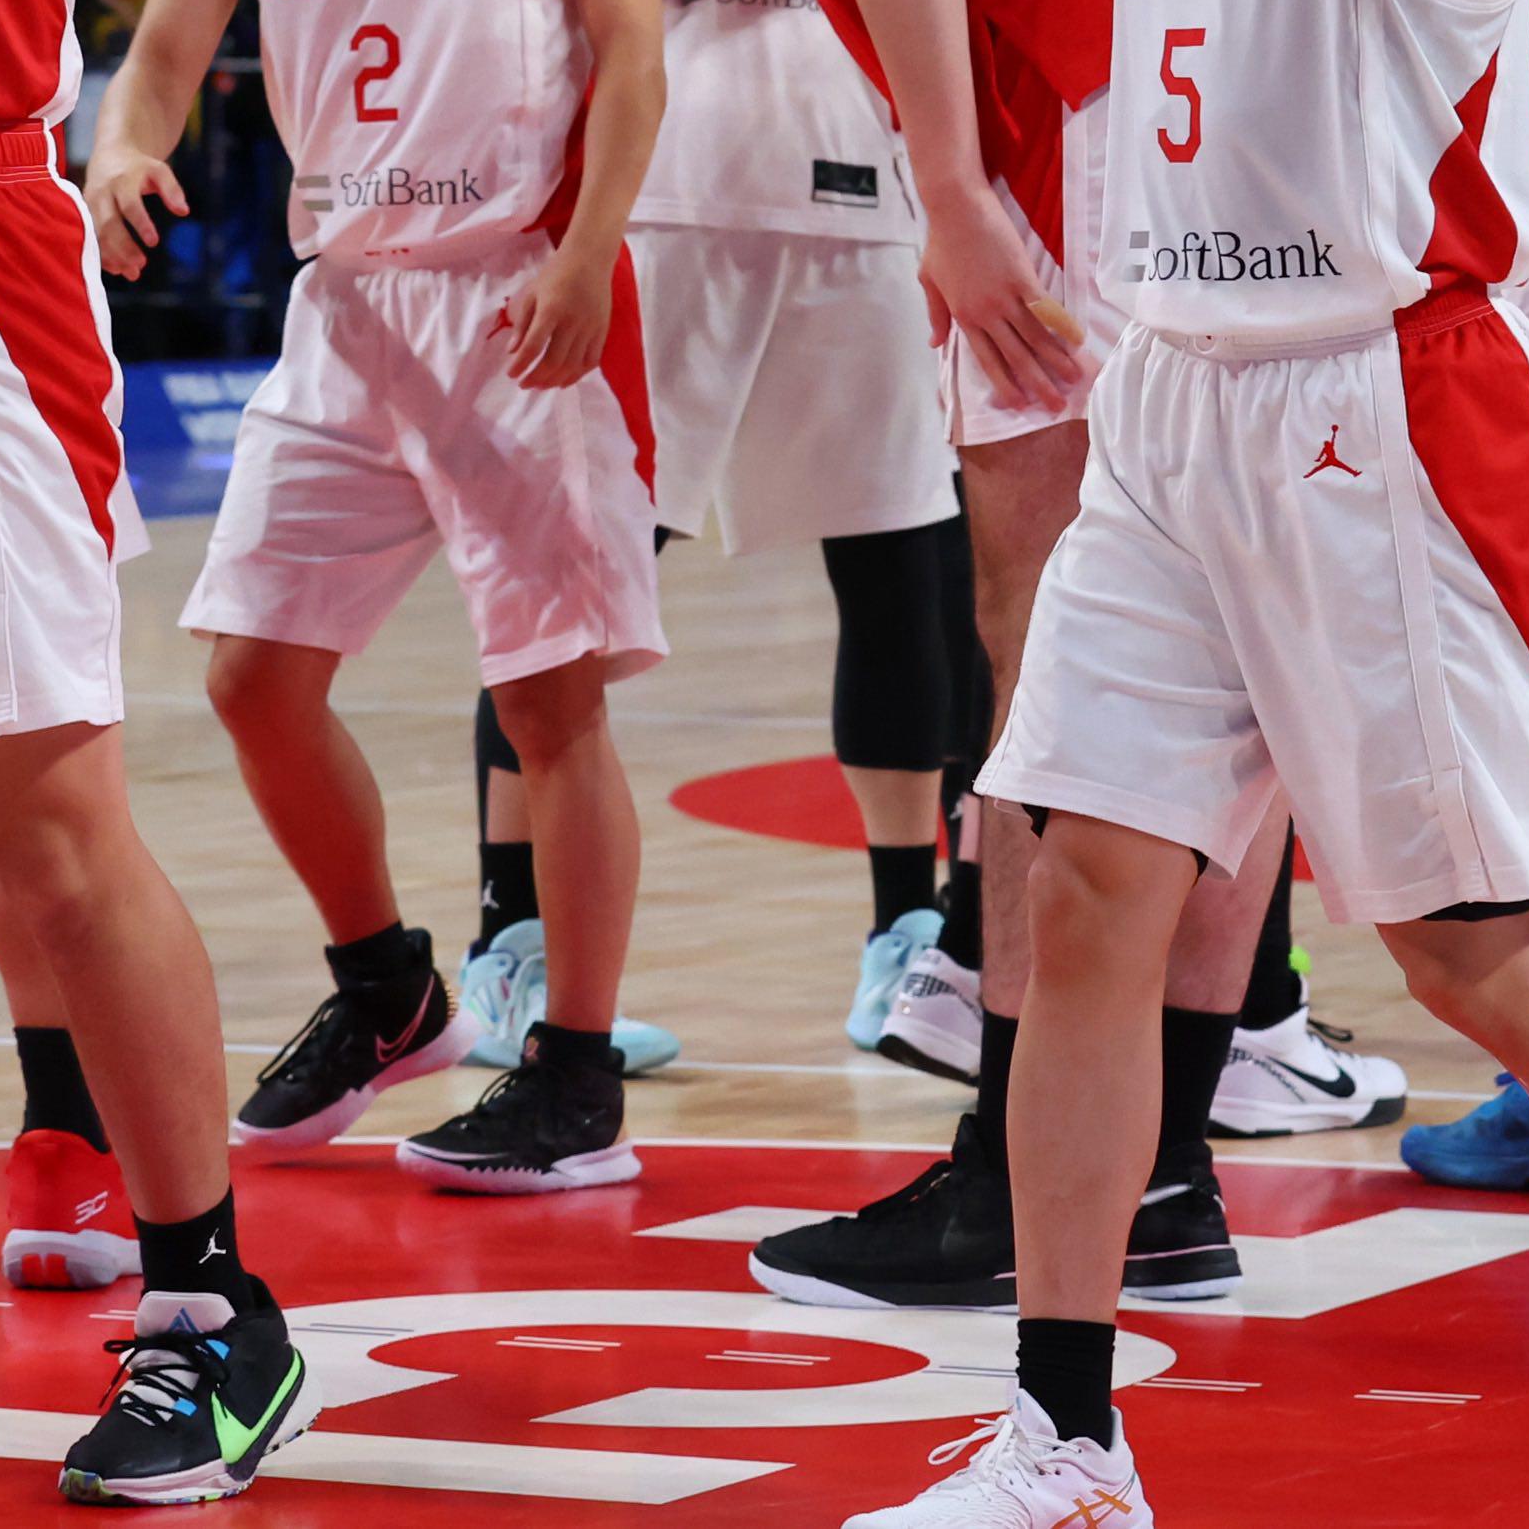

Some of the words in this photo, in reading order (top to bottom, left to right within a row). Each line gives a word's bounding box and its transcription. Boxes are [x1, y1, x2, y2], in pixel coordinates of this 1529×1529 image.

[349, 23, 401, 123] 2
[1156, 27, 1207, 163] 5
[1147, 228, 1343, 282] oftBank
